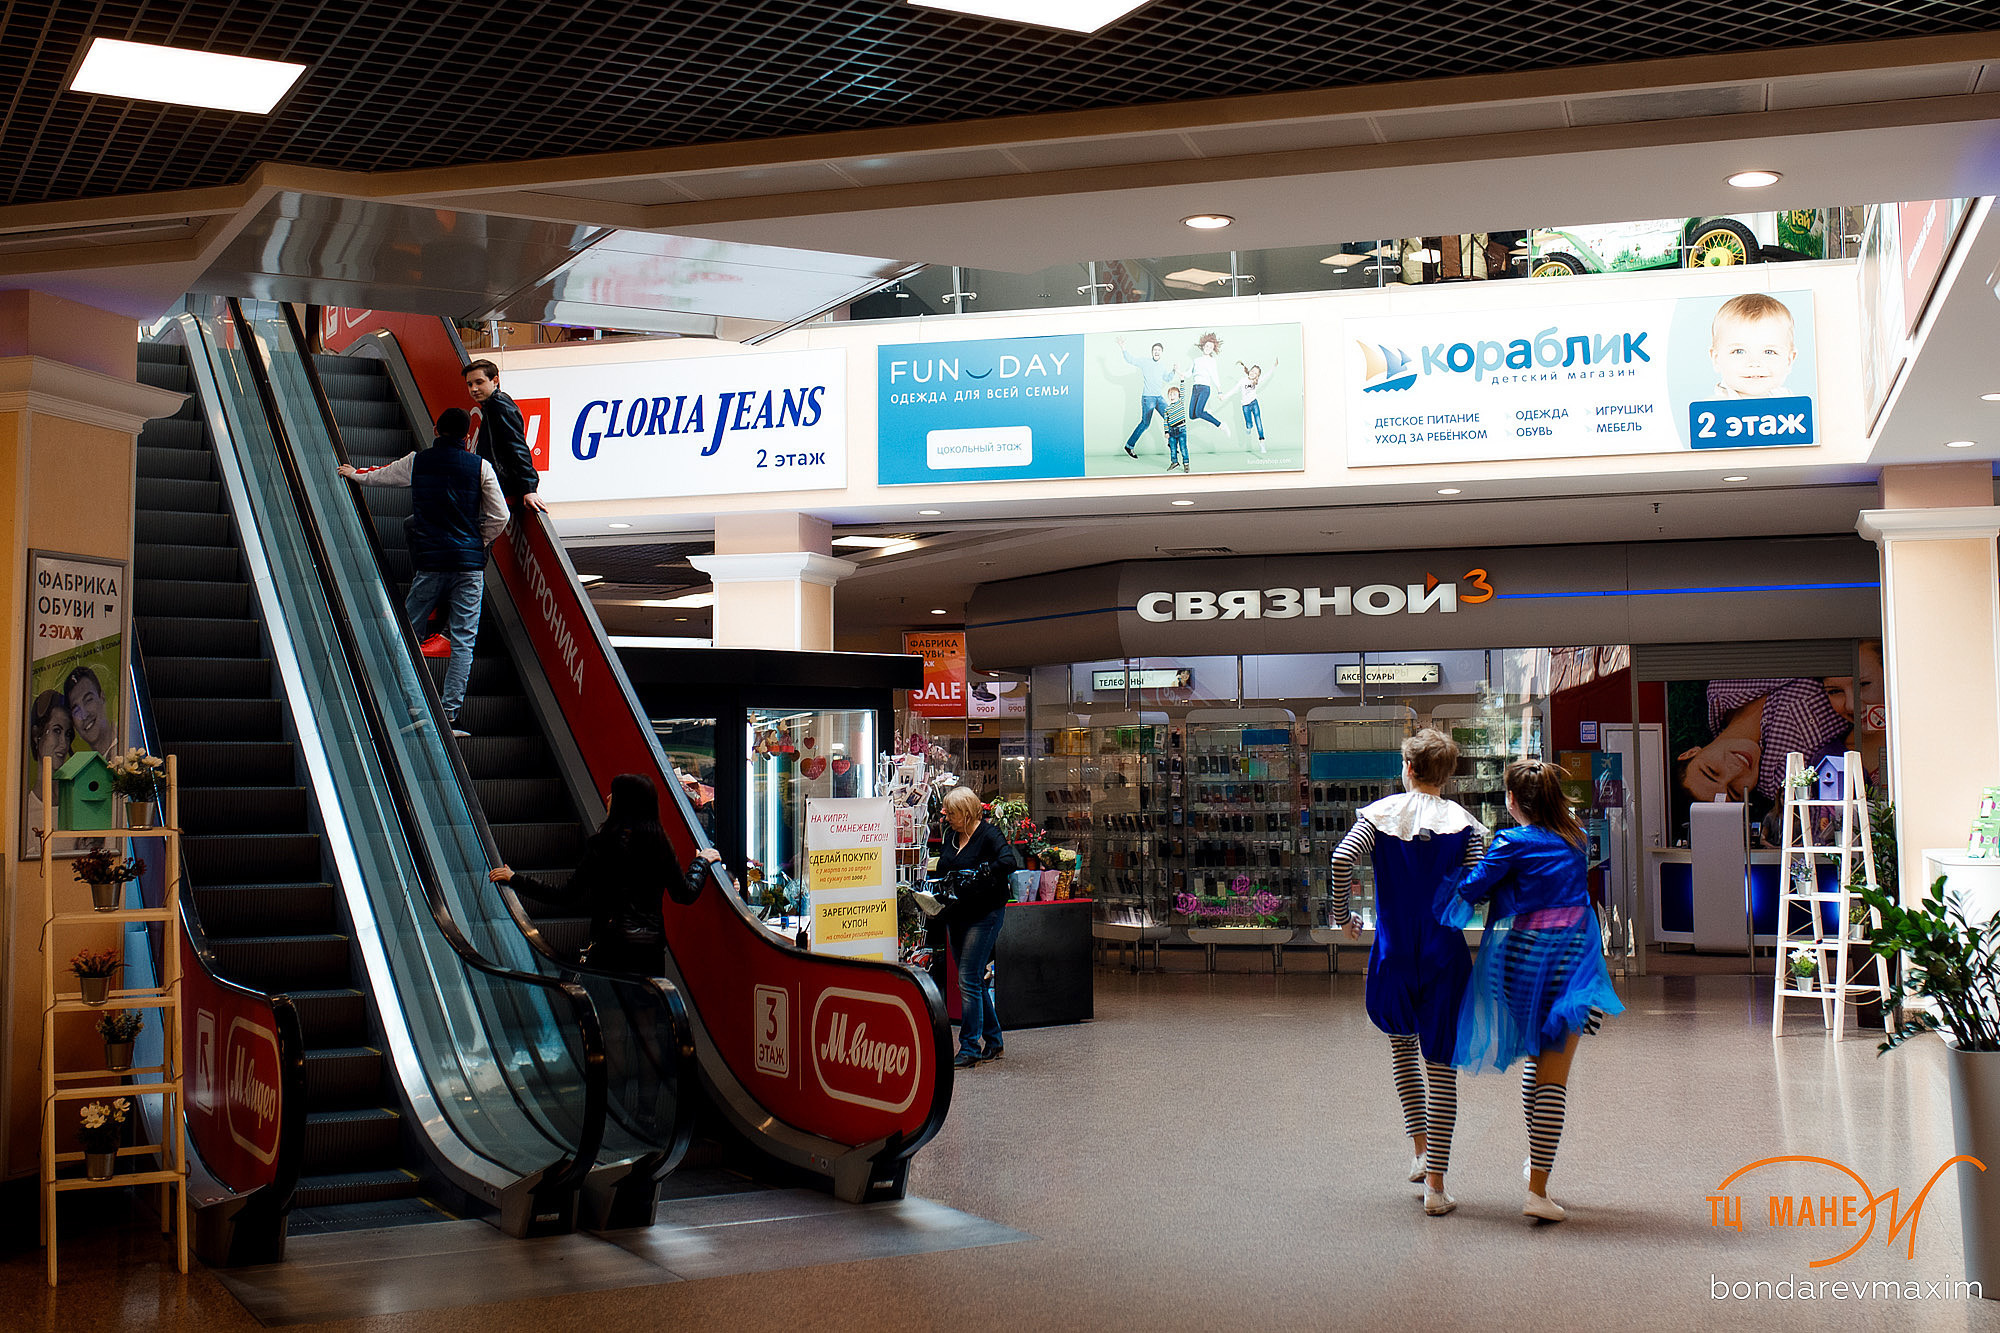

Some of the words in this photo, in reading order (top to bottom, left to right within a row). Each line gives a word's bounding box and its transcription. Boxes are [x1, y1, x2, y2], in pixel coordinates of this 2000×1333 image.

[1421, 326, 1651, 382] кораблик
[890, 358, 959, 385] FUN
[999, 352, 1070, 379] DAY
[1491, 371, 1558, 385] детский
[1567, 367, 1636, 380] магазин
[890, 391, 947, 406] ОДЕЖДА
[954, 389, 980, 403] ДЛЯ
[987, 385, 1019, 399] ВСЕЙ
[1025, 385, 1070, 397] СЕМЬИ
[1515, 408, 1569, 421] ОДЕЖДА
[1595, 404, 1654, 416] ИГРУШКИ
[1374, 415, 1424, 429] ДЕТСКОЕ
[1427, 412, 1480, 426] ПИТАНИЕ
[1595, 421, 1643, 434] МЕБЕЛЬ
[1696, 411, 1718, 438] 2
[1725, 409, 1807, 437] этаж
[1374, 433, 1407, 445] УХОД
[1409, 432, 1424, 443] ЗА
[1427, 428, 1488, 442] РЕБЁНКОМ
[1515, 426, 1553, 437] ОБУВЬ
[936, 442, 994, 455] цокольный
[996, 442, 1022, 452] этаж
[756, 449, 768, 469] 2
[774, 451, 826, 468] этаж
[38, 569, 118, 597] ФАБРИКА
[1136, 571, 1458, 623] СВЯЗНОЙ
[38, 595, 95, 619] ОБУВИ
[39, 623, 47, 638] 2
[48, 624, 84, 641] ЭТАЖ
[910, 639, 959, 648] ФАБРИКА
[1099, 678, 1144, 687] ТЕЛЕФНЫ
[1340, 673, 1395, 681] АКСЕСУАРЫ
[912, 682, 962, 700] SALE
[811, 815, 822, 823] НА
[823, 813, 849, 822] КИПР?!
[830, 824, 835, 833] С
[836, 823, 881, 833] МАНЕЖЕМ?!
[860, 833, 889, 843] ЛЕГКО!!!
[809, 851, 841, 866] СДЕЛАЙ
[842, 851, 879, 862] ПОКУПКУ
[822, 901, 887, 918] ЗАРЕГИСТРИРУЙ
[841, 918, 868, 929] КУПОН
[833, 931, 852, 940] стойке
[852, 929, 884, 940] регистрации
[765, 996, 777, 1042] 3
[758, 1043, 785, 1066] ЭТАЖ
[821, 1011, 910, 1084] М.видео
